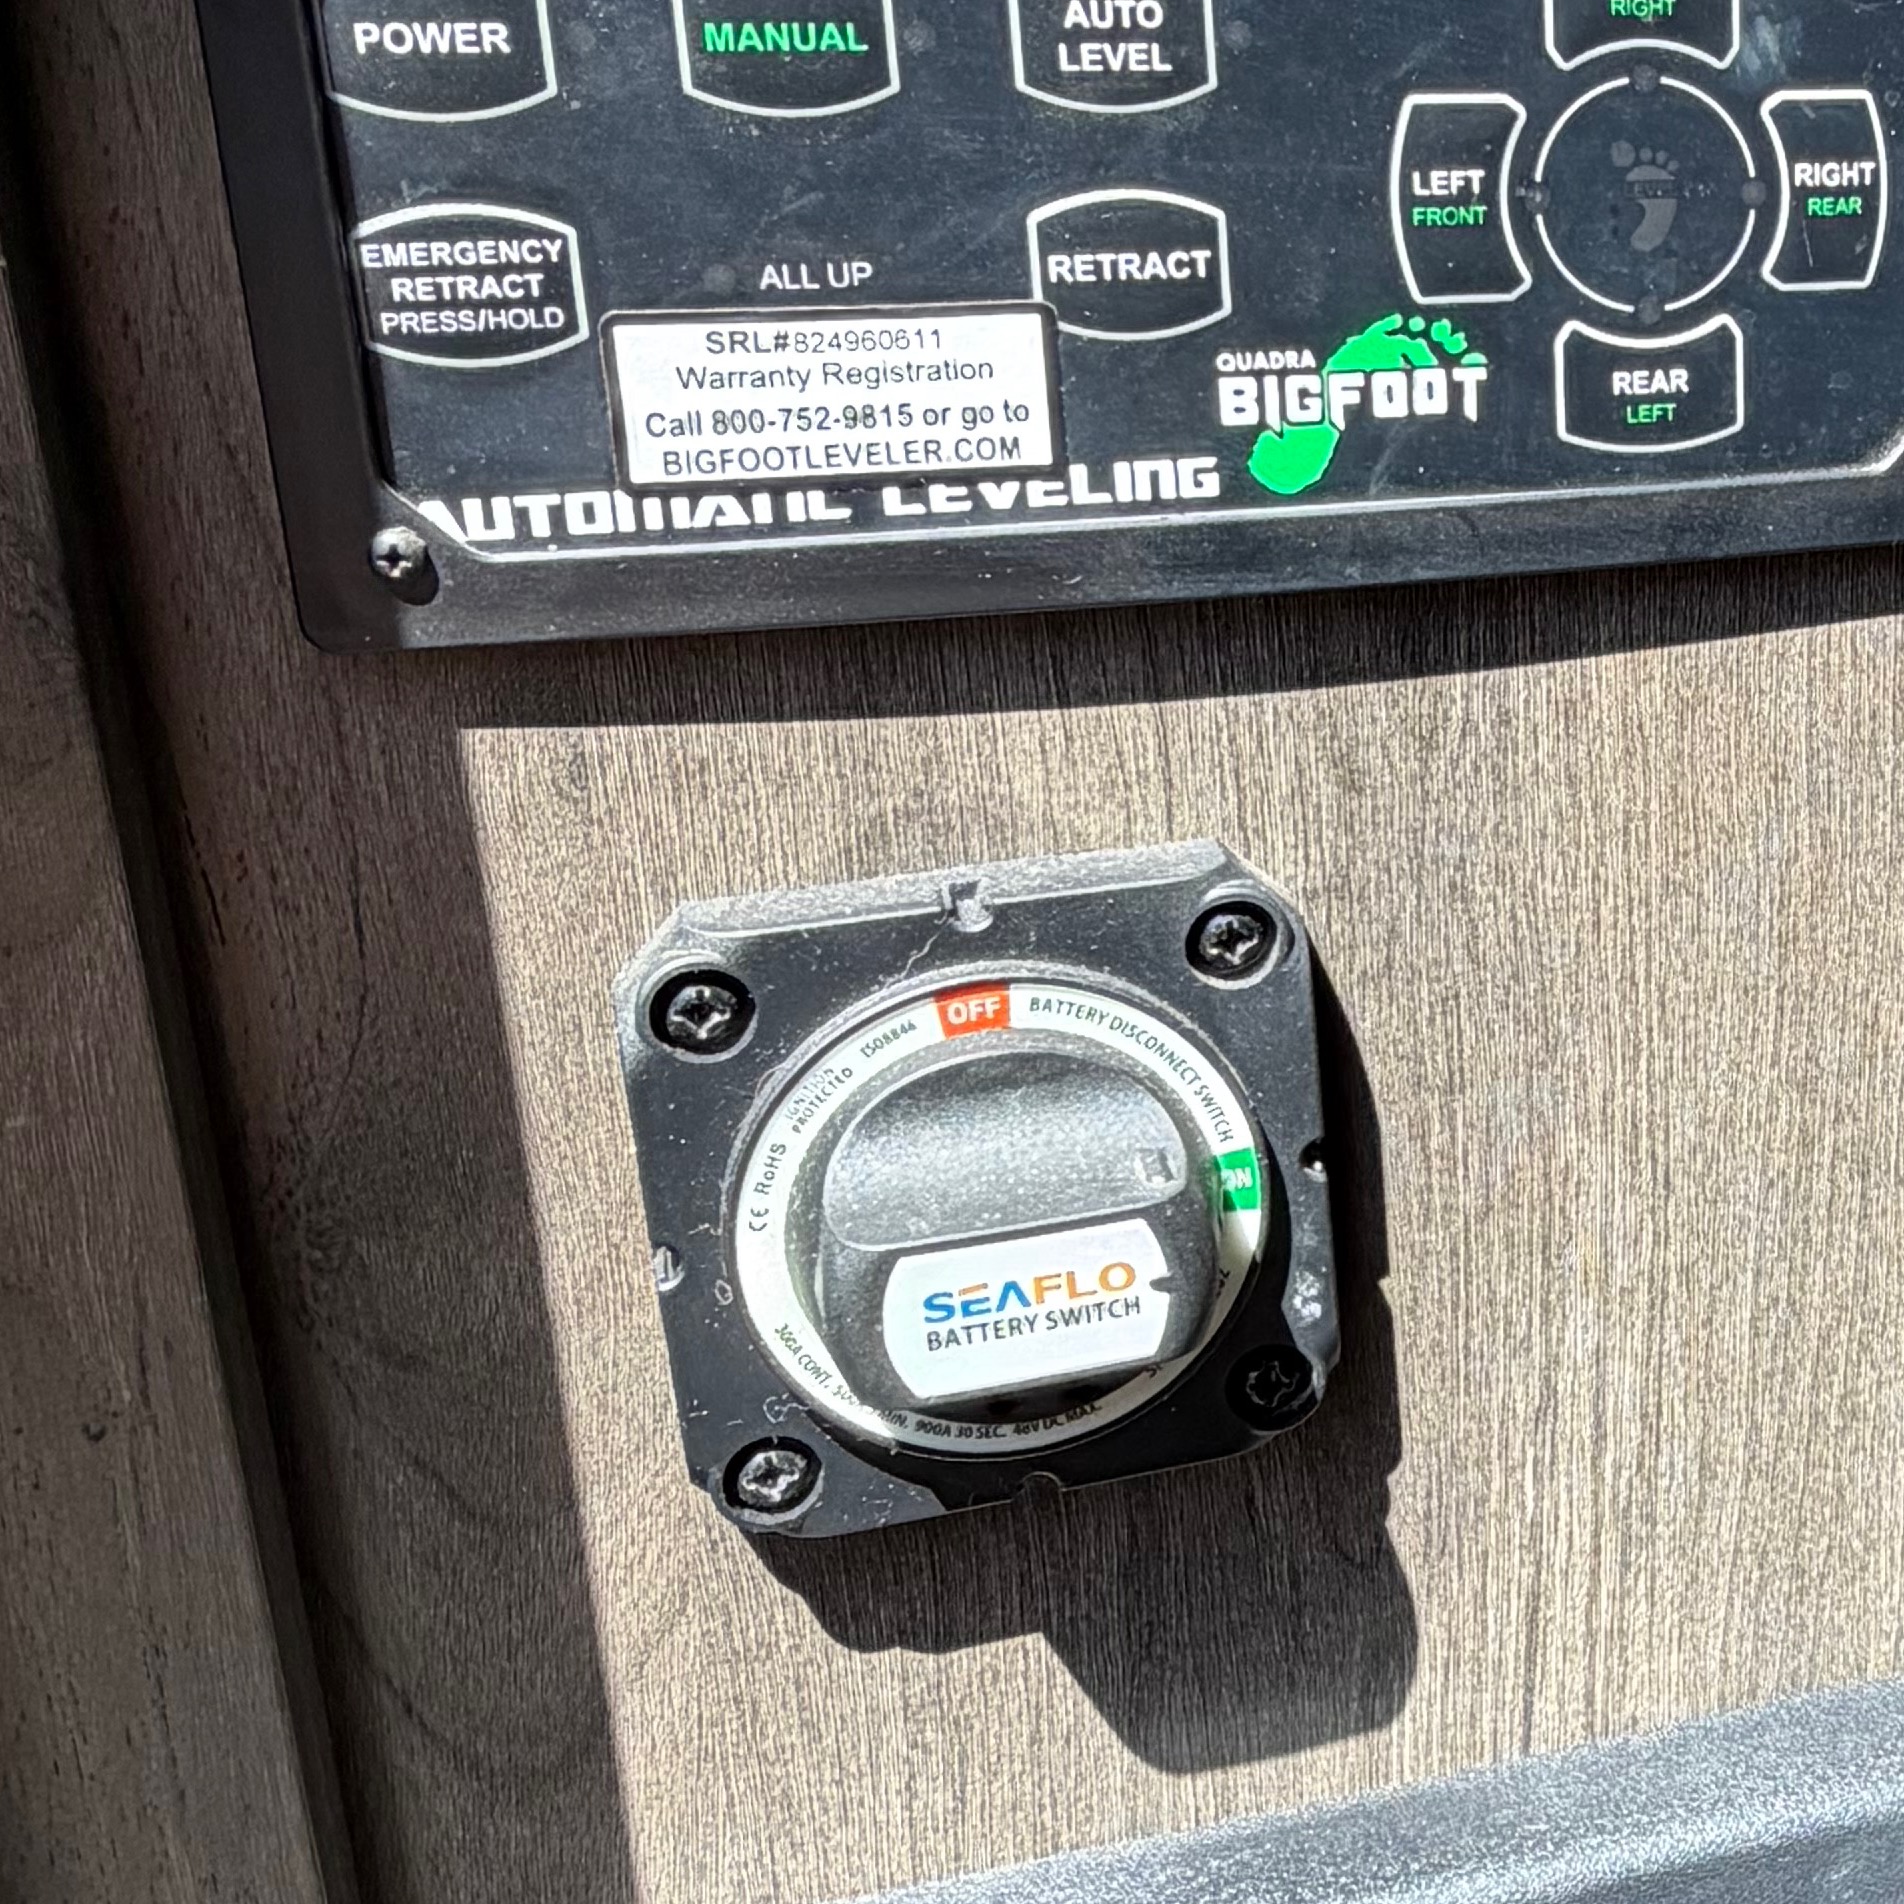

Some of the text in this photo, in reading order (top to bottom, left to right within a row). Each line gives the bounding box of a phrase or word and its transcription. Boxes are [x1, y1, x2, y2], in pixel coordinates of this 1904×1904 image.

[352, 21, 513, 55] POWER
[702, 21, 869, 54] MANUAL
[1057, 41, 1172, 73] LEVEL
[1411, 169, 1486, 197] LEFT
[1793, 161, 1876, 187] RIGHT
[1411, 206, 1488, 227] FRONT
[1806, 196, 1863, 217] REAR
[360, 237, 564, 269] EMERGENCY
[1046, 249, 1212, 284] RETRACT
[391, 271, 545, 303] RETRACT
[759, 260, 874, 291] ALL UP
[379, 305, 566, 336] PRESS/HOLD
[675, 358, 995, 394] Warranty Registration
[1215, 348, 1317, 373] QUADRA
[1612, 369, 1690, 396] REAR
[1217, 366, 1489, 433] BIGFOOT
[1625, 404, 1677, 426] LEFT
[645, 398, 1031, 439] Call 800-752-9815 or go to
[661, 435, 1022, 477] BIGFOOTLEVELER.COM
[881, 456, 1220, 517] LEVELING
[946, 997, 1003, 1025] OFF
[1029, 996, 1234, 1144] BATTERY DISCONNECT SWITCH
[752, 1142, 788, 1196] RoHS
[1221, 1166, 1254, 1192] ON
[922, 1261, 1137, 1325] SEAFLO
[926, 1295, 1141, 1352] BATTERY SWITCH
[914, 1420, 952, 1439] 900A
